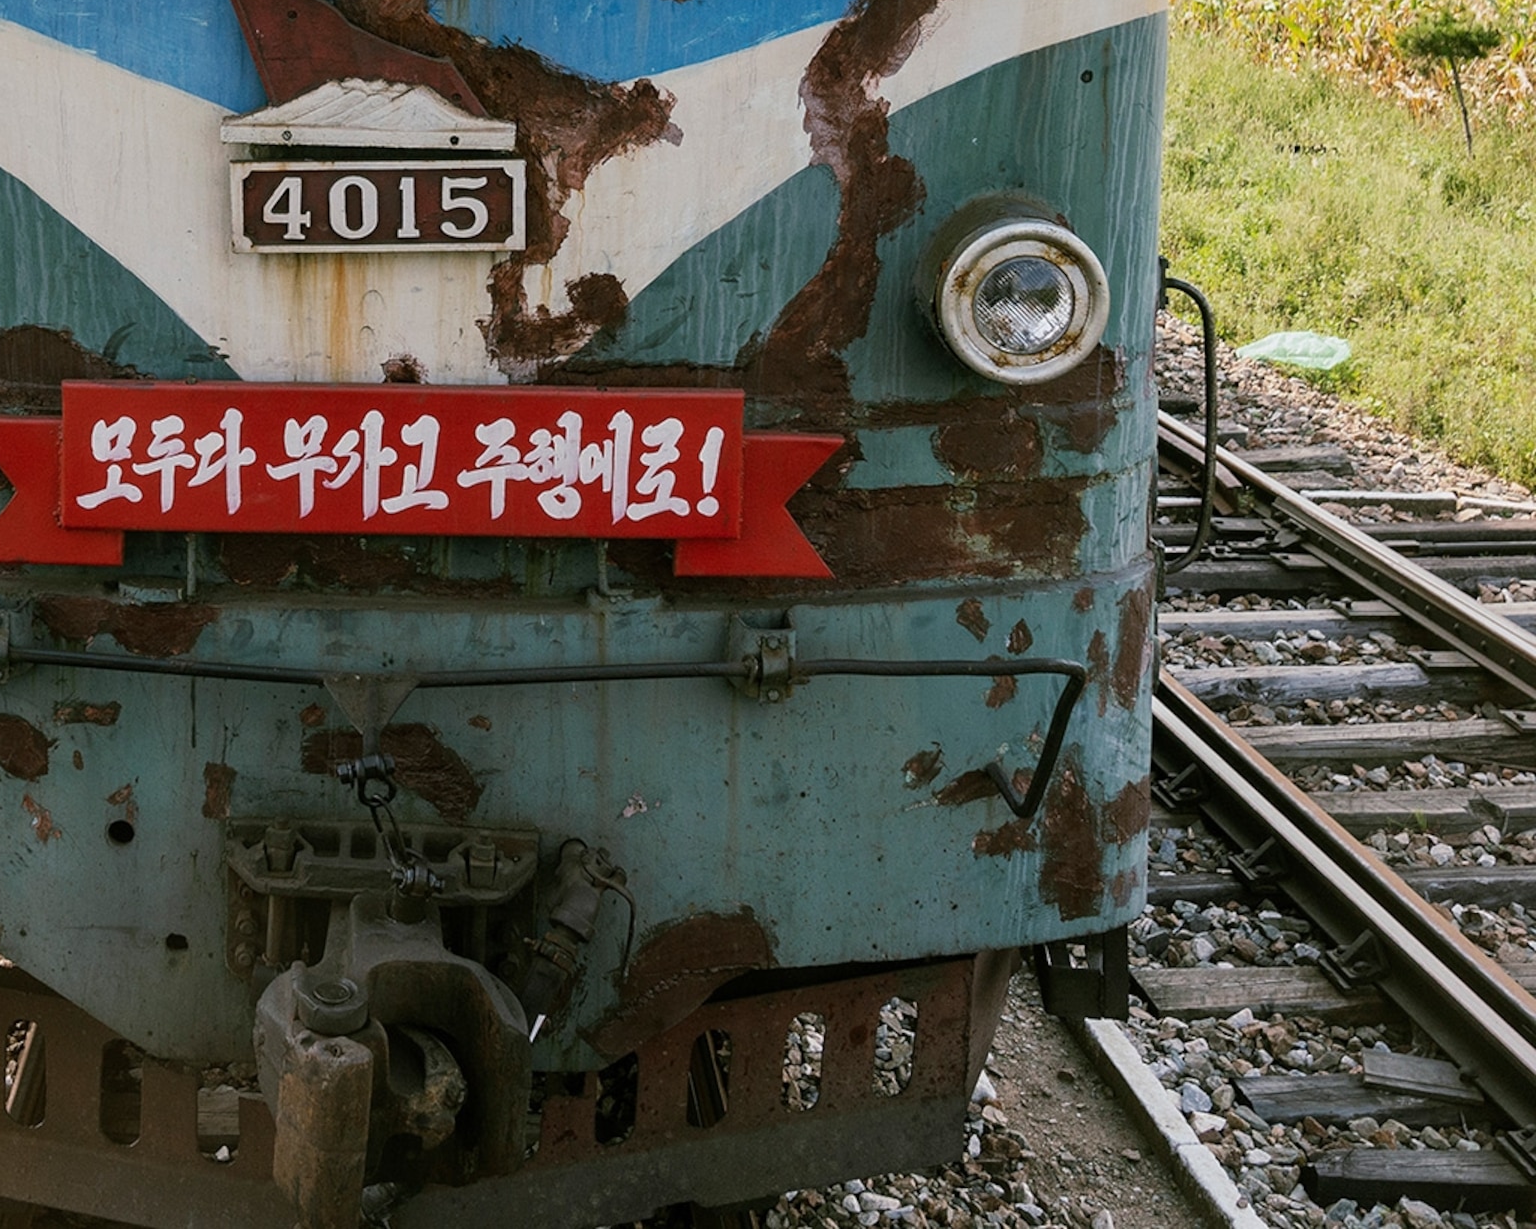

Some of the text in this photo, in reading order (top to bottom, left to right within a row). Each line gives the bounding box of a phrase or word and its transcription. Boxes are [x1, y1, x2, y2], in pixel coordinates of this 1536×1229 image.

[263, 175, 488, 240] 4015
[75, 407, 725, 526] 모두다 무사고 주행에로!
